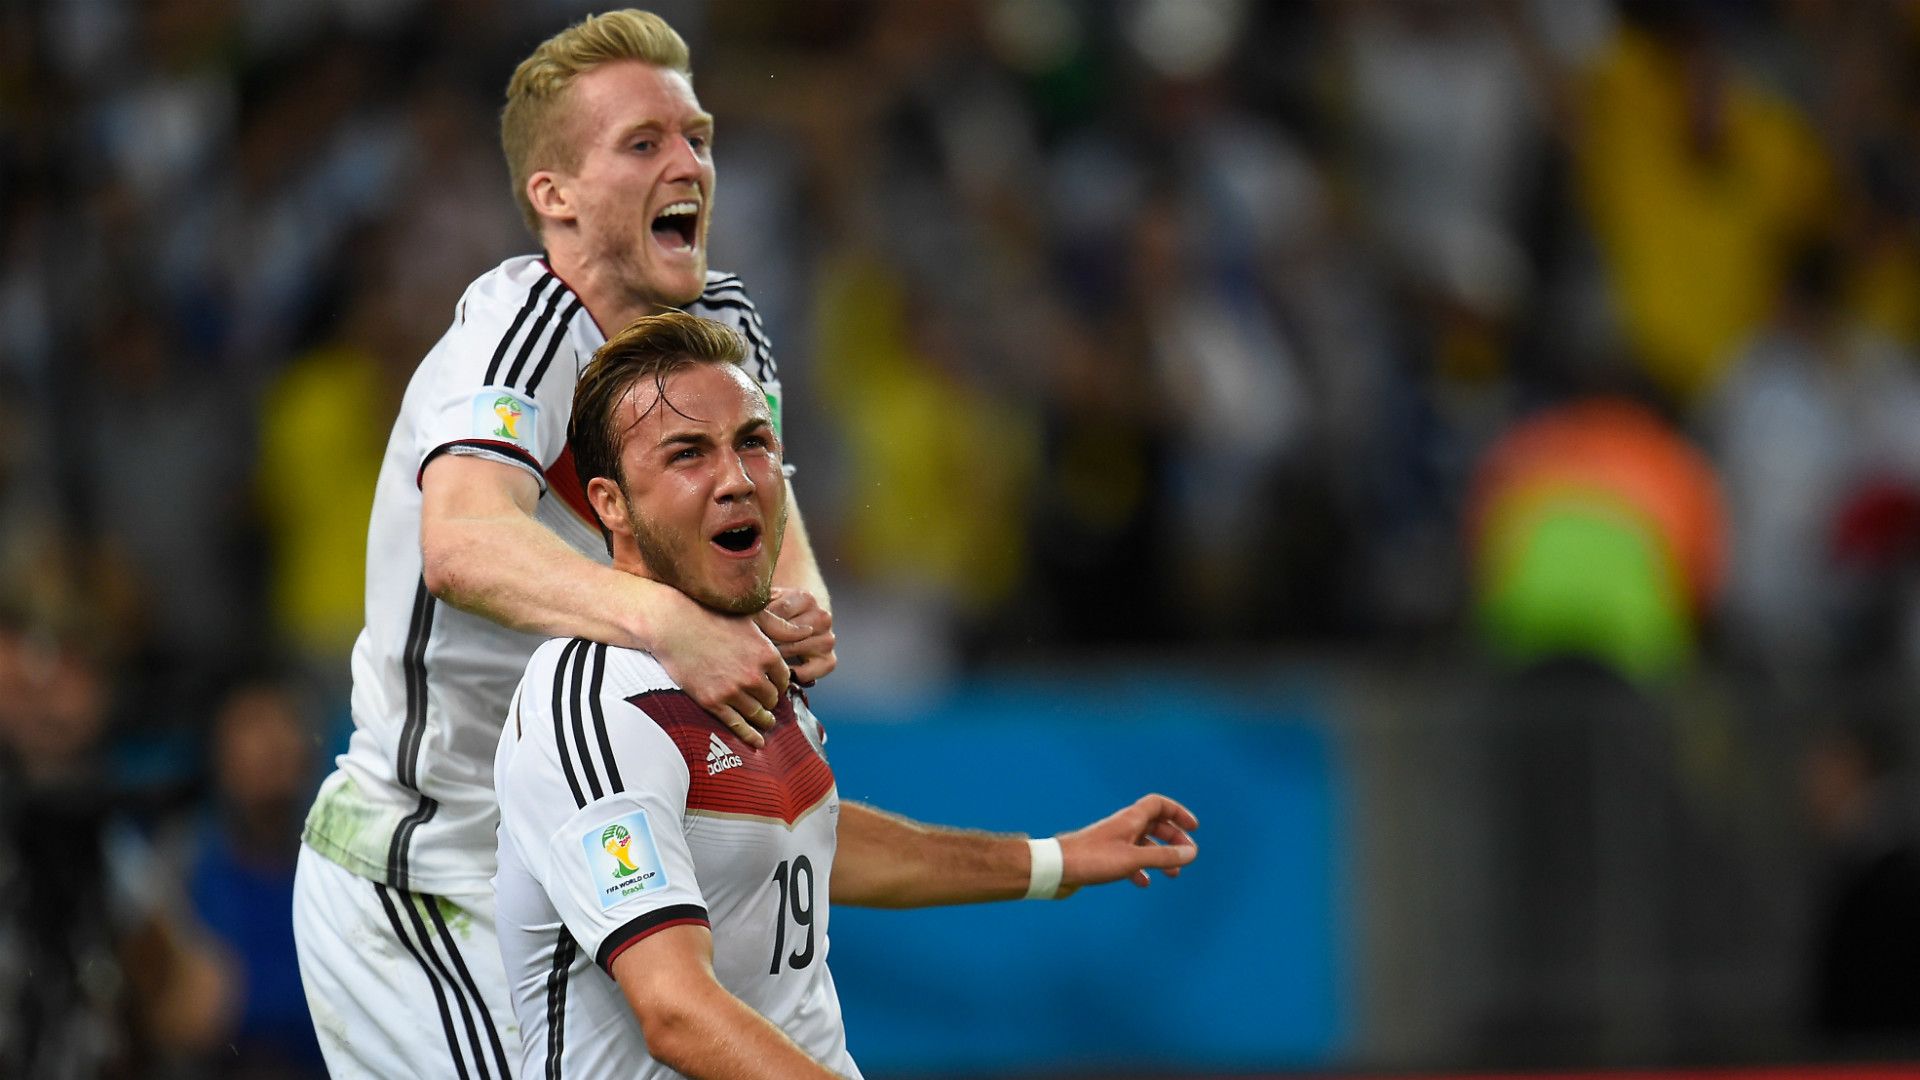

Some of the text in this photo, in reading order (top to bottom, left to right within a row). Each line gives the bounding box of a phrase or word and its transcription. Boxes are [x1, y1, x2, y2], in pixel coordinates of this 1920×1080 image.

[706, 755, 743, 776] adidas
[606, 872, 656, 894] FIFA WORLD CUP
[622, 883, 644, 896] Brasil
[769, 854, 815, 975] 19
